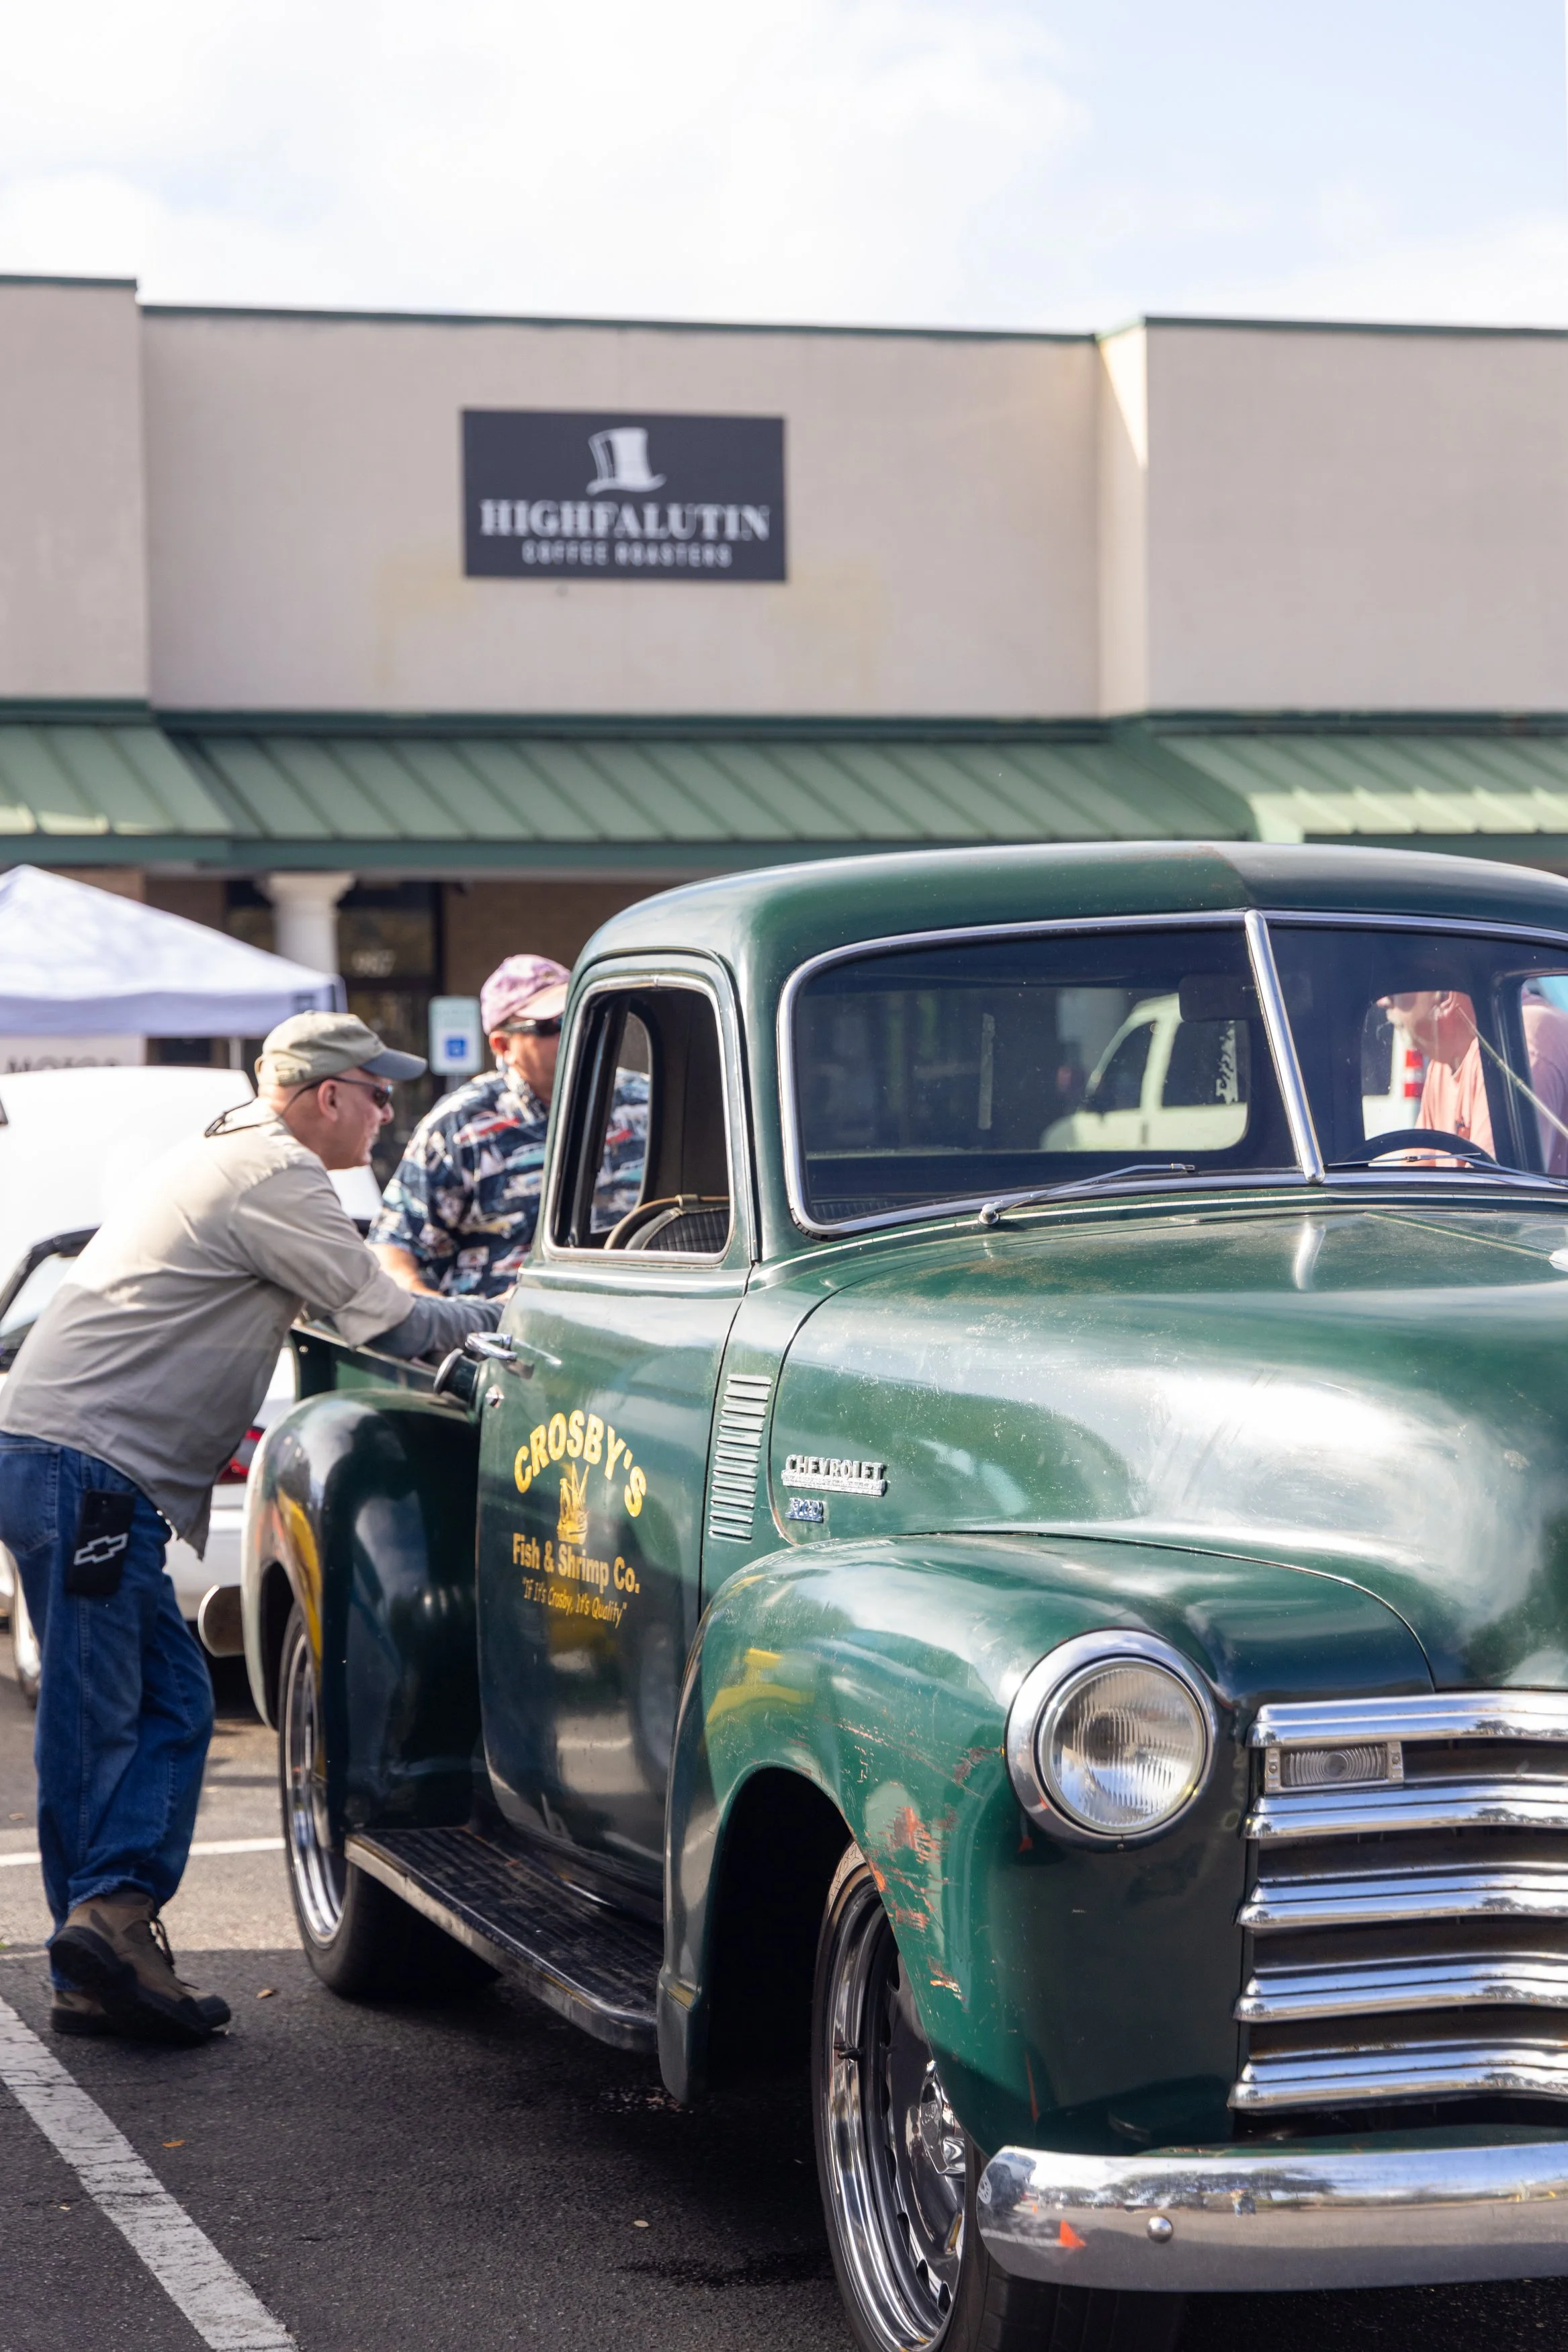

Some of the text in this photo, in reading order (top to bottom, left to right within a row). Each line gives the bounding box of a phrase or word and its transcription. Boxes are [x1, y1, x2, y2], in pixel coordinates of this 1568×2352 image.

[480, 499, 771, 541] HIGHFALUTIN
[522, 540, 609, 566] COFFEE
[514, 1410, 647, 1517] CROSBY'S
[785, 1454, 885, 1482] CHEVROLET
[513, 1532, 640, 1594] Fish & Shrimp Co.
